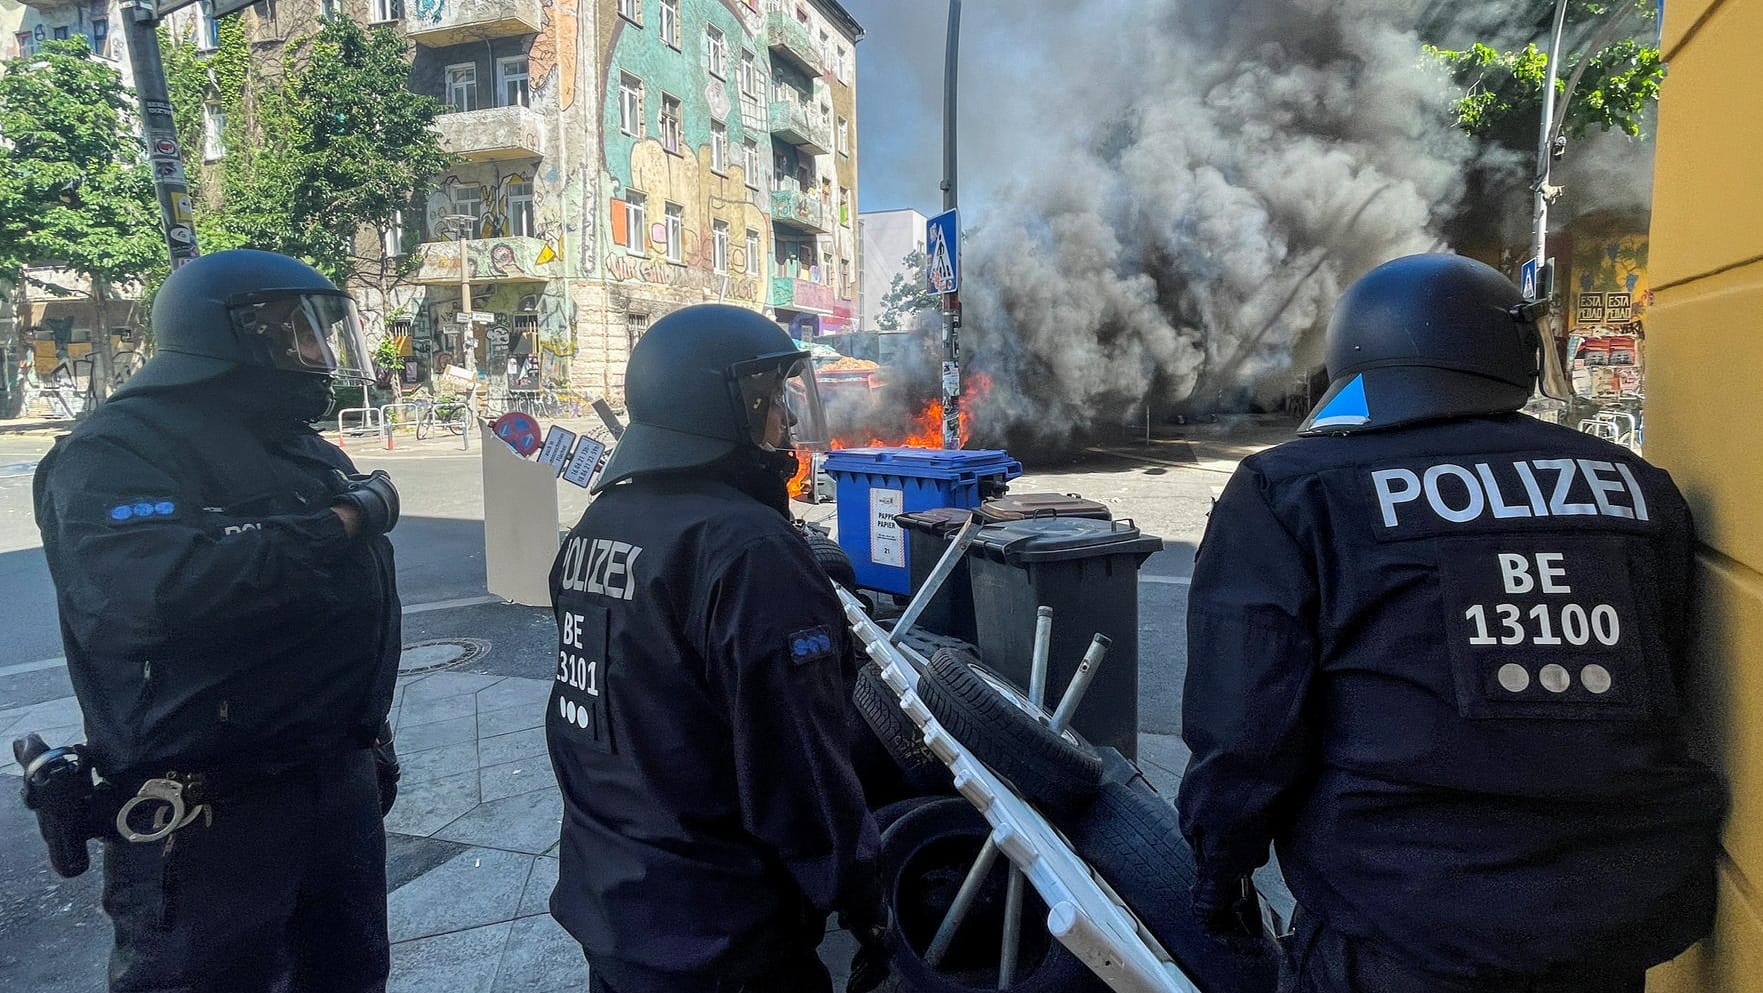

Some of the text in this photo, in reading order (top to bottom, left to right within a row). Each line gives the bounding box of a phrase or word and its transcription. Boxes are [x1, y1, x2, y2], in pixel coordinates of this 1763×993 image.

[1580, 296, 1601, 307] ESTA
[1608, 296, 1629, 307] ESTA
[1371, 458, 1649, 528] POLIZEI
[878, 512, 894, 520] PAPPE
[562, 536, 643, 601] OLIZEI
[1498, 552, 1571, 594] BE
[563, 611, 585, 649] BE
[1464, 603, 1620, 646] 13100
[556, 650, 599, 697] 3101
